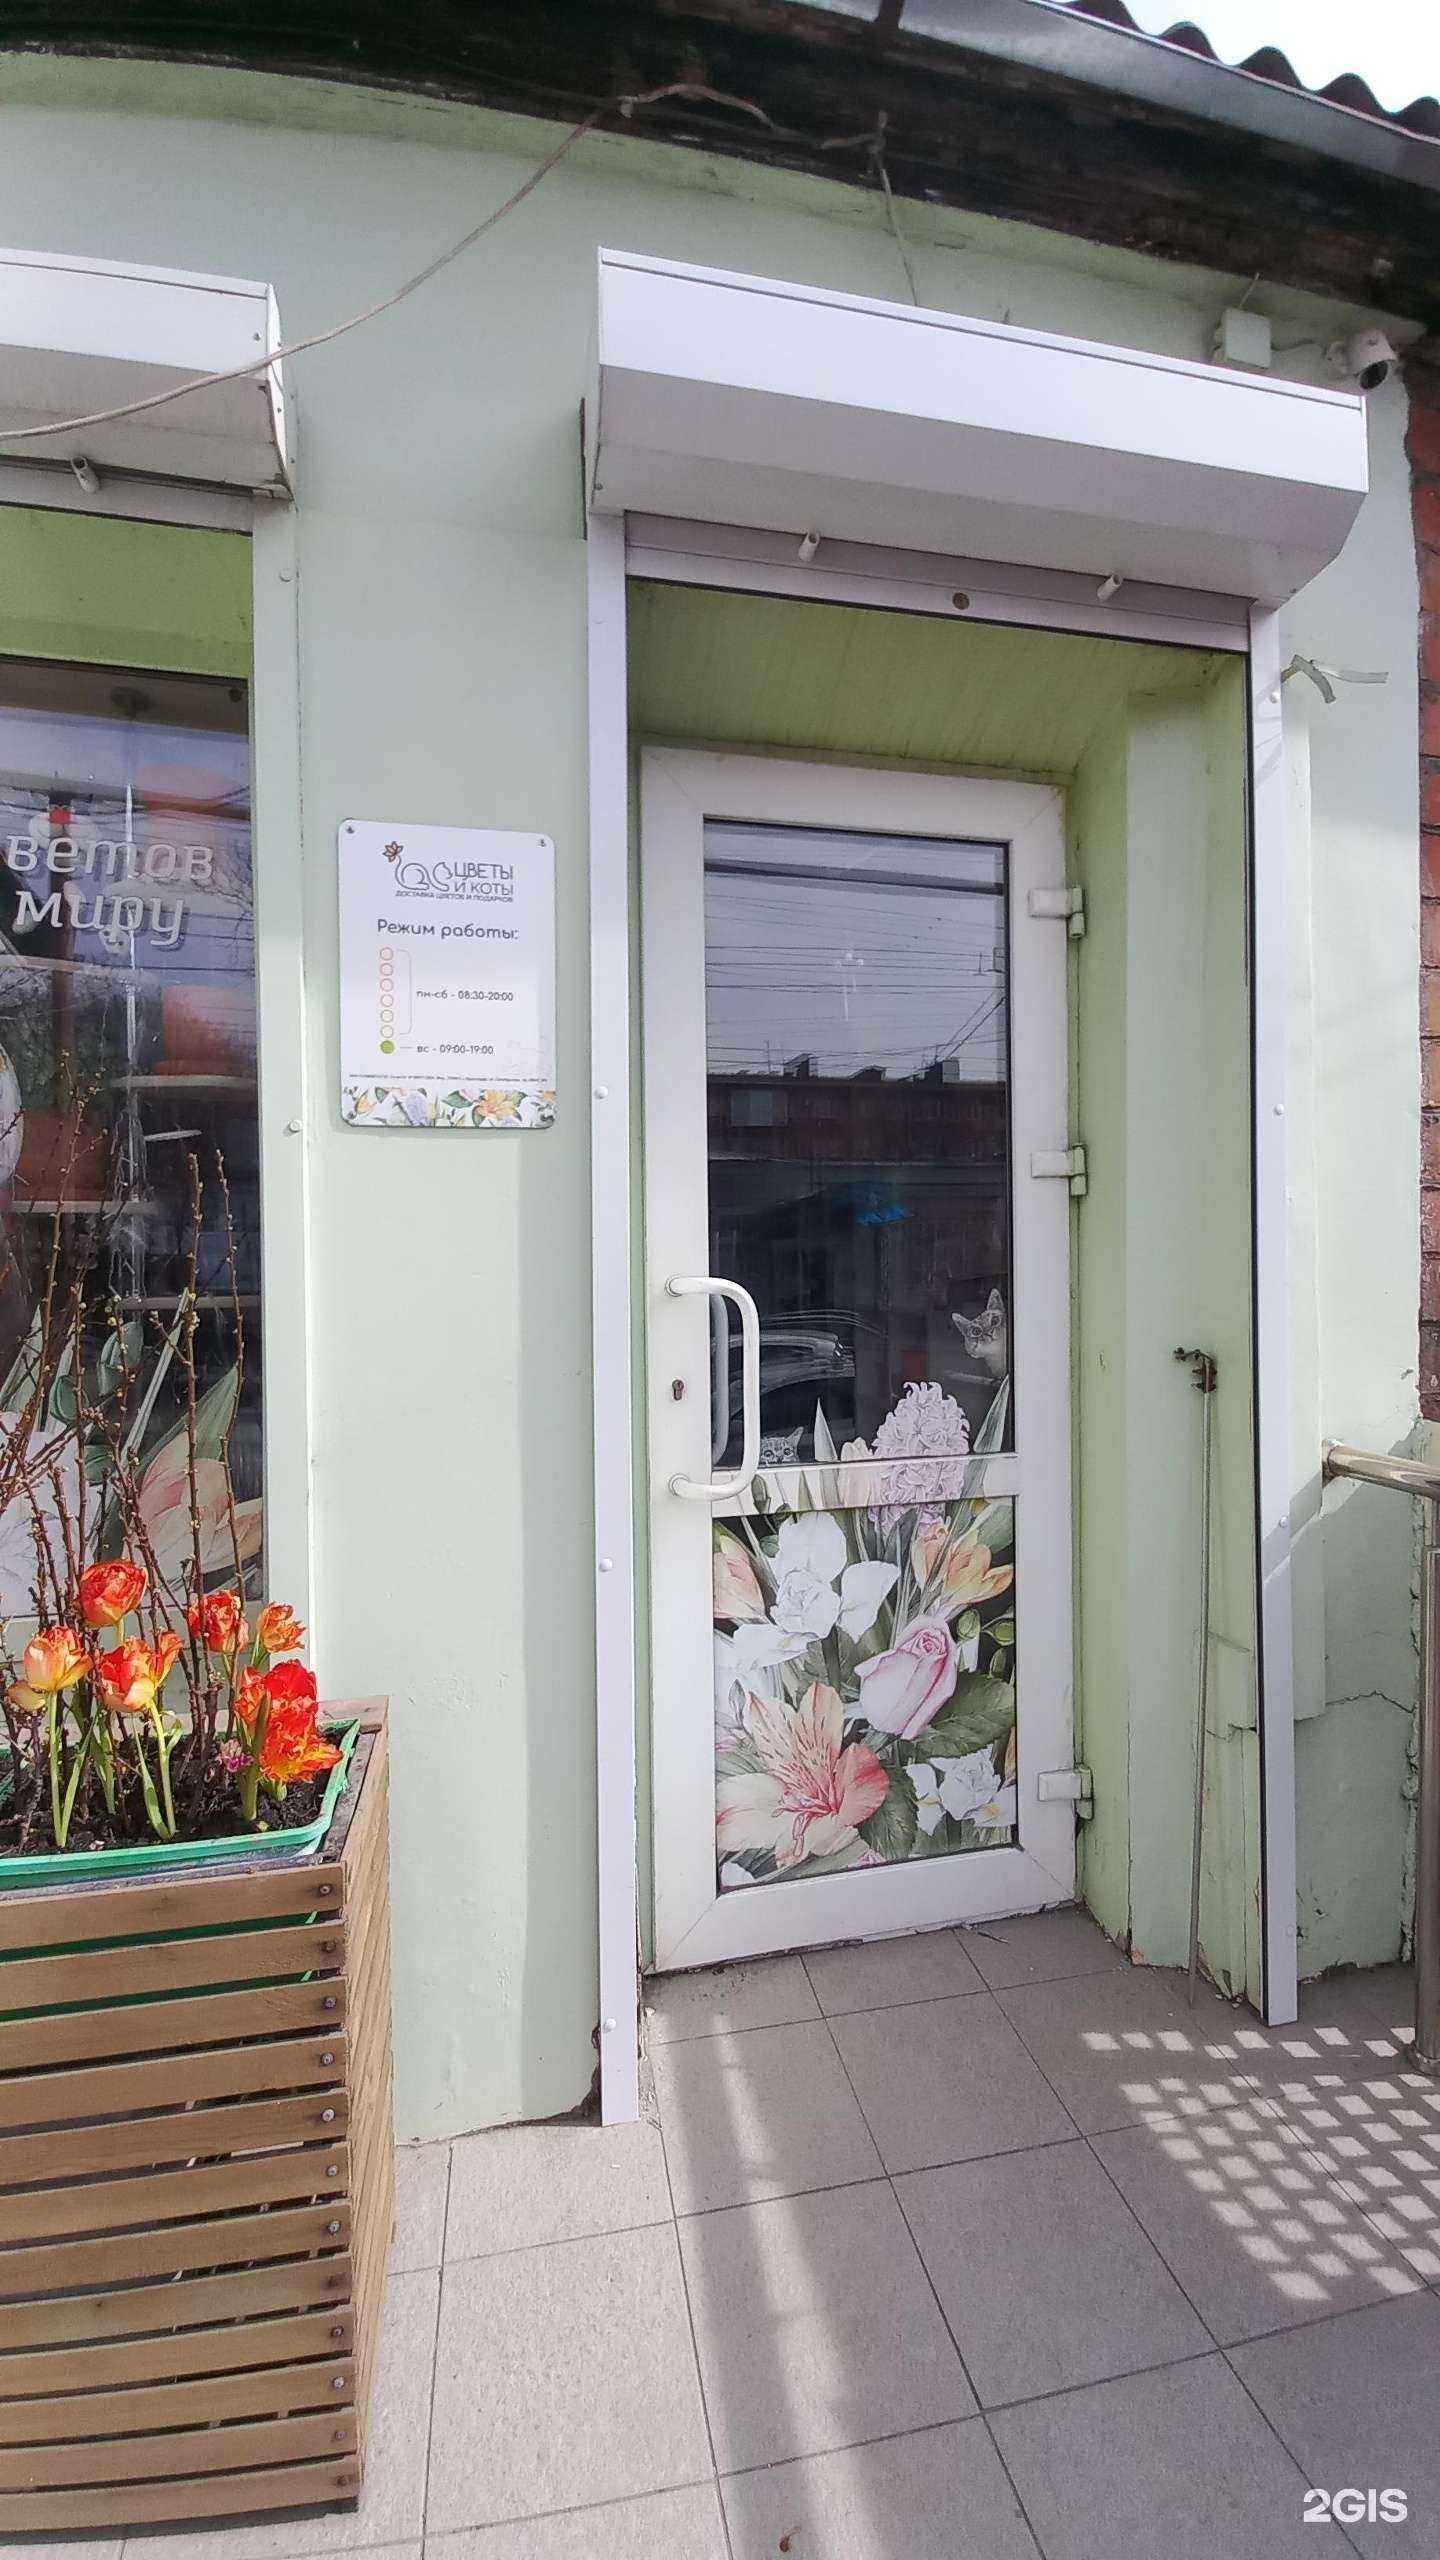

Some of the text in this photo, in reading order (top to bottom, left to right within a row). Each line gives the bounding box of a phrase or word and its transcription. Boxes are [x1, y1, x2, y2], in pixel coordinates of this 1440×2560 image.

[454, 861, 514, 881] ЦВЕТЫ
[454, 882, 514, 896] И КОТЫ
[15, 890, 184, 946] миру
[377, 918, 520, 940] Режим работы:
[416, 989, 448, 999] пн-сб
[457, 990, 514, 1001] 08:30-20:00
[439, 1044, 494, 1055] 09:00-19:00
